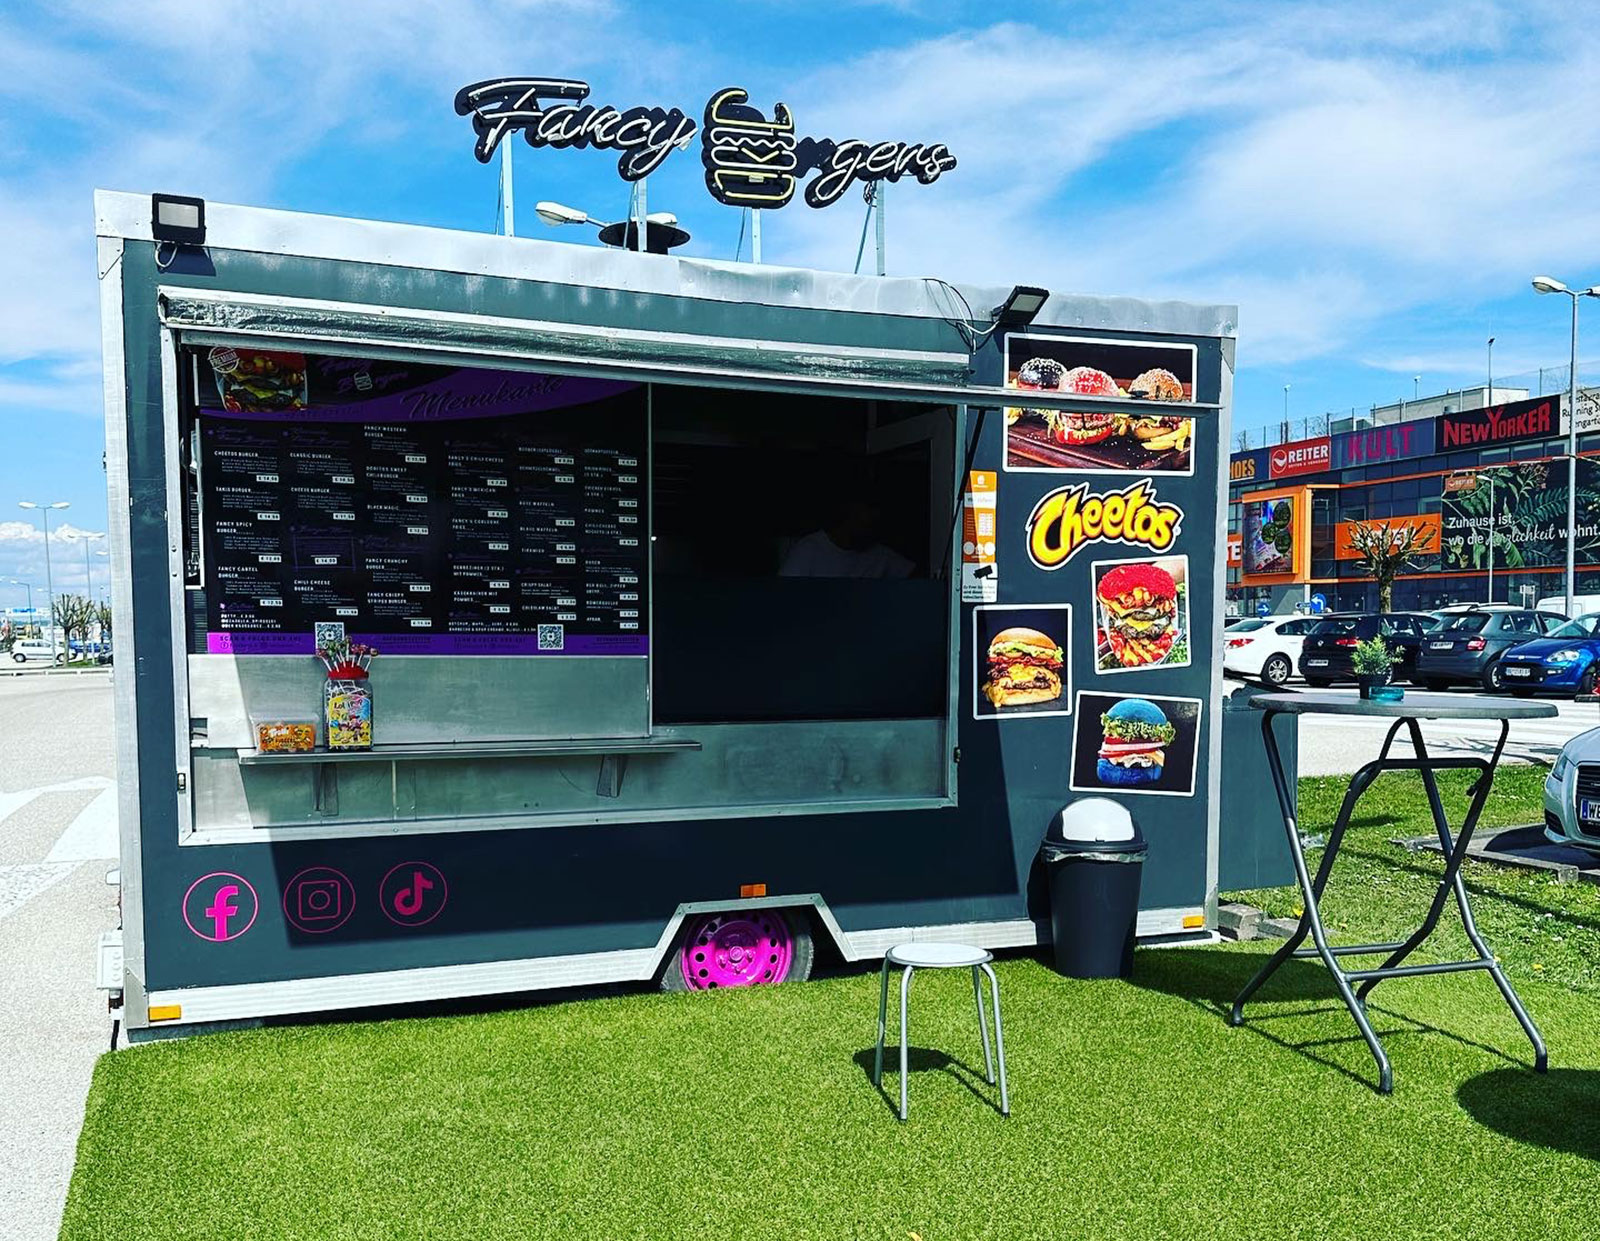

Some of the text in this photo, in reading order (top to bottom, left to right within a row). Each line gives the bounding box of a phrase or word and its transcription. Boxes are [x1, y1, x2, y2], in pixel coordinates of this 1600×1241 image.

[457, 78, 698, 181] Fancy
[1288, 444, 1329, 464] REITER
[1347, 426, 1415, 462] KULT
[1029, 482, 1182, 568] Cheetos
[1448, 513, 1516, 529] Zuhause ist,
[1448, 535, 1464, 547] wo
